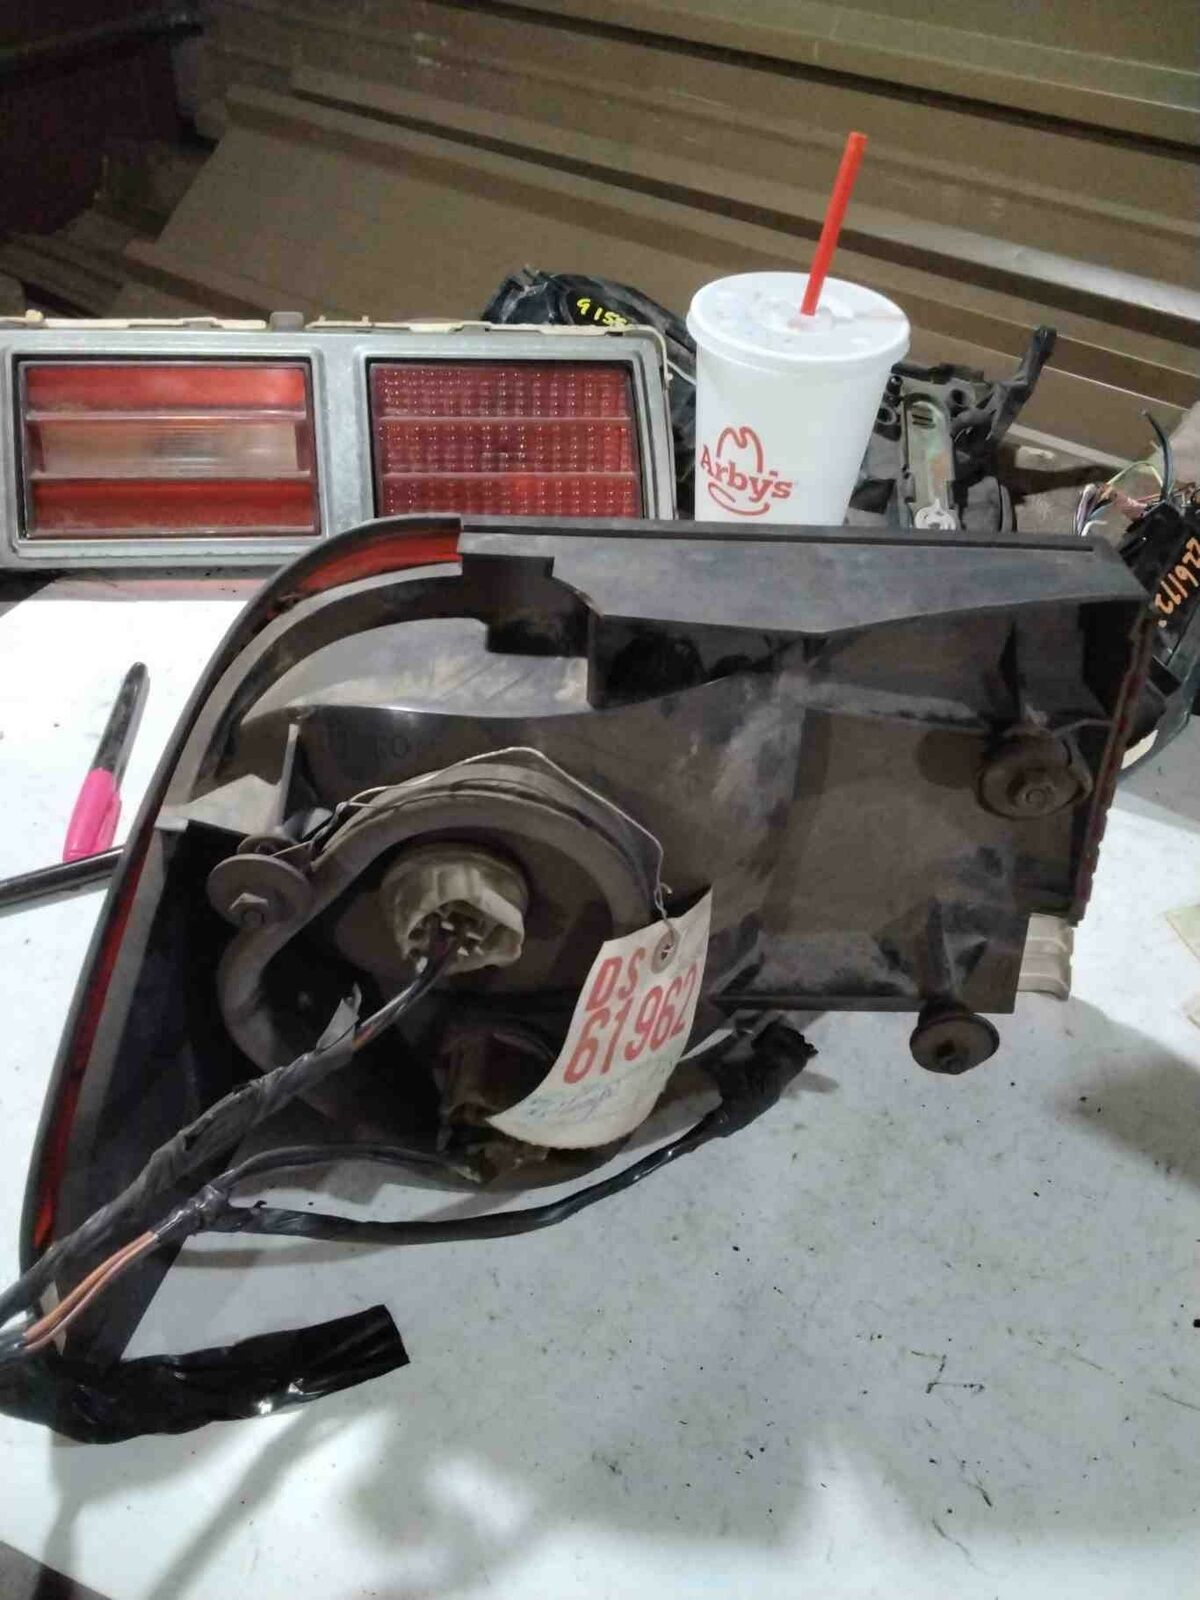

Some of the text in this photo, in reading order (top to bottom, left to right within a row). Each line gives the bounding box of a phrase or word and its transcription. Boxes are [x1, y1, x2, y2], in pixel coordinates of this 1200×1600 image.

[701, 444, 793, 503] Arby's
[585, 947, 646, 1012] DS
[563, 963, 698, 1084] 61962
